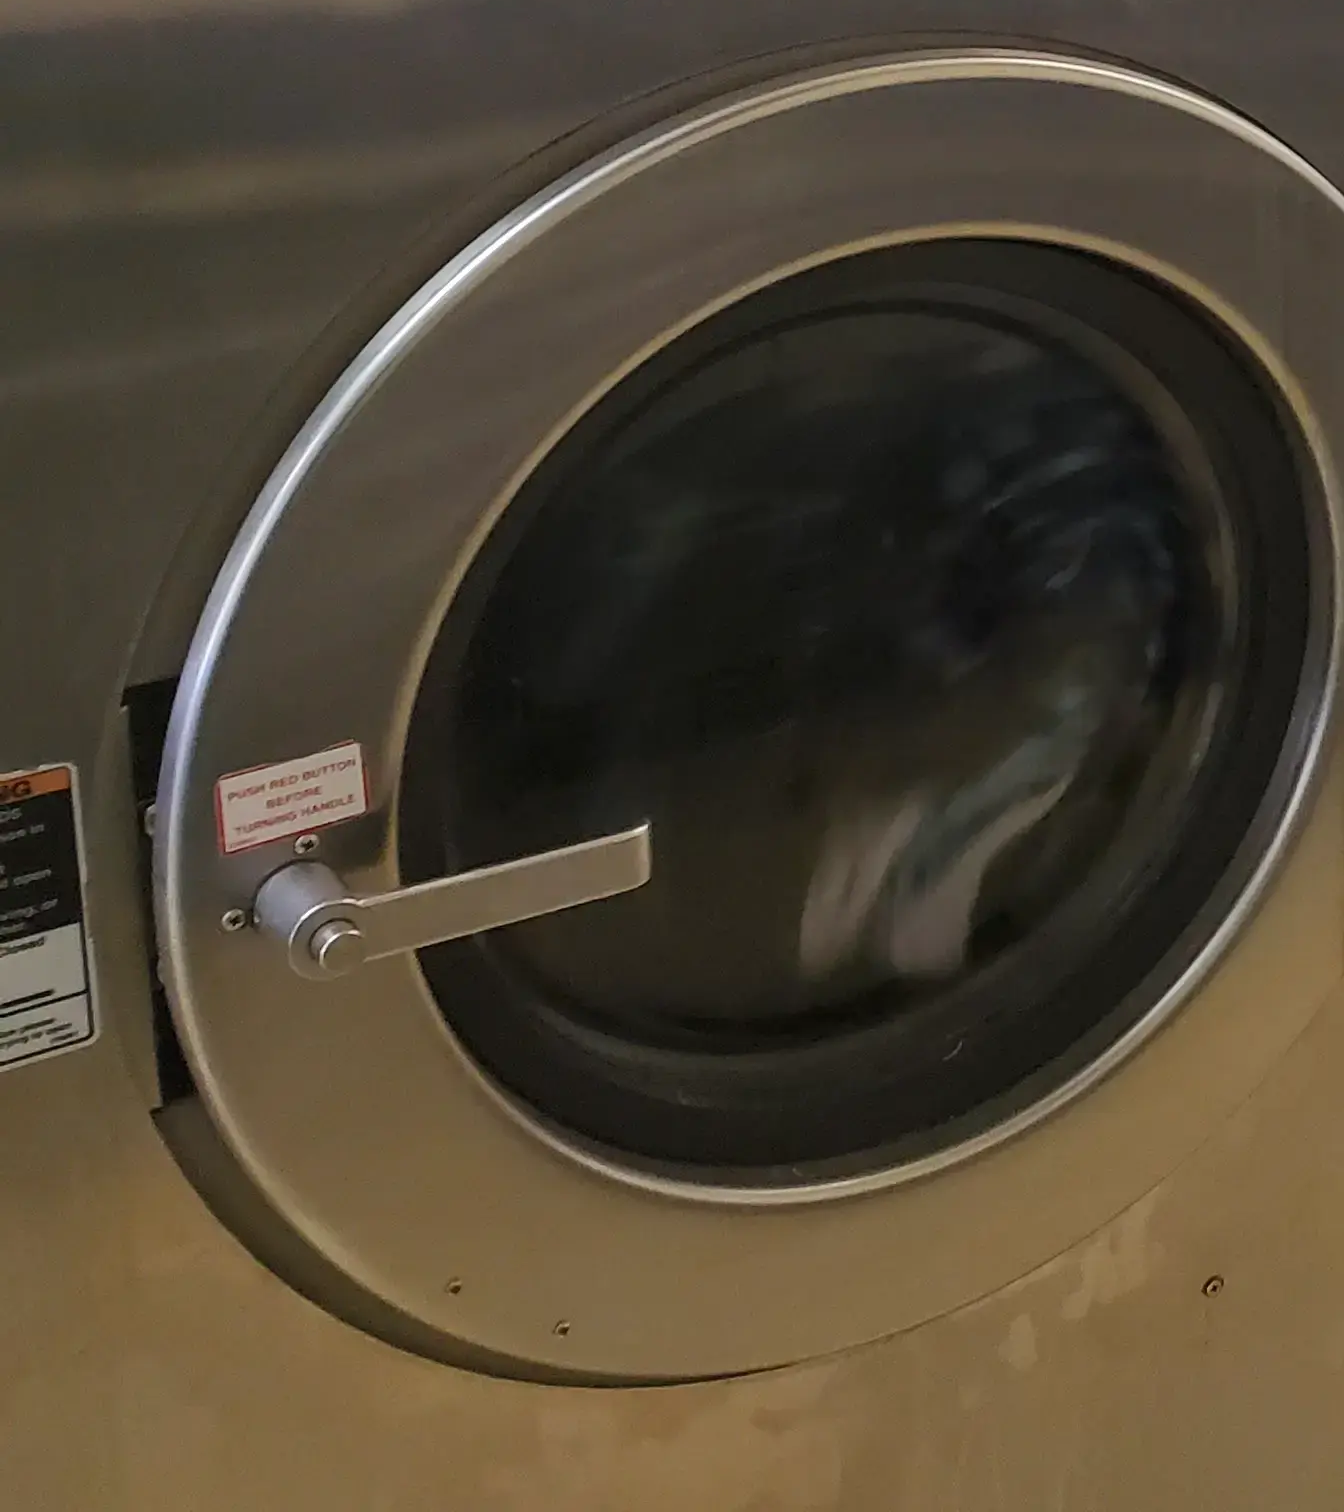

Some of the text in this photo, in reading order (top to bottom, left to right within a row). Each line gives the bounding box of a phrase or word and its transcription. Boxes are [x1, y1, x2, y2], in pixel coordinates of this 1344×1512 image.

[269, 775, 299, 790] RED
[302, 758, 357, 781] BUTTON
[266, 786, 323, 809] BEFORE
[301, 794, 355, 816] HANDLE
